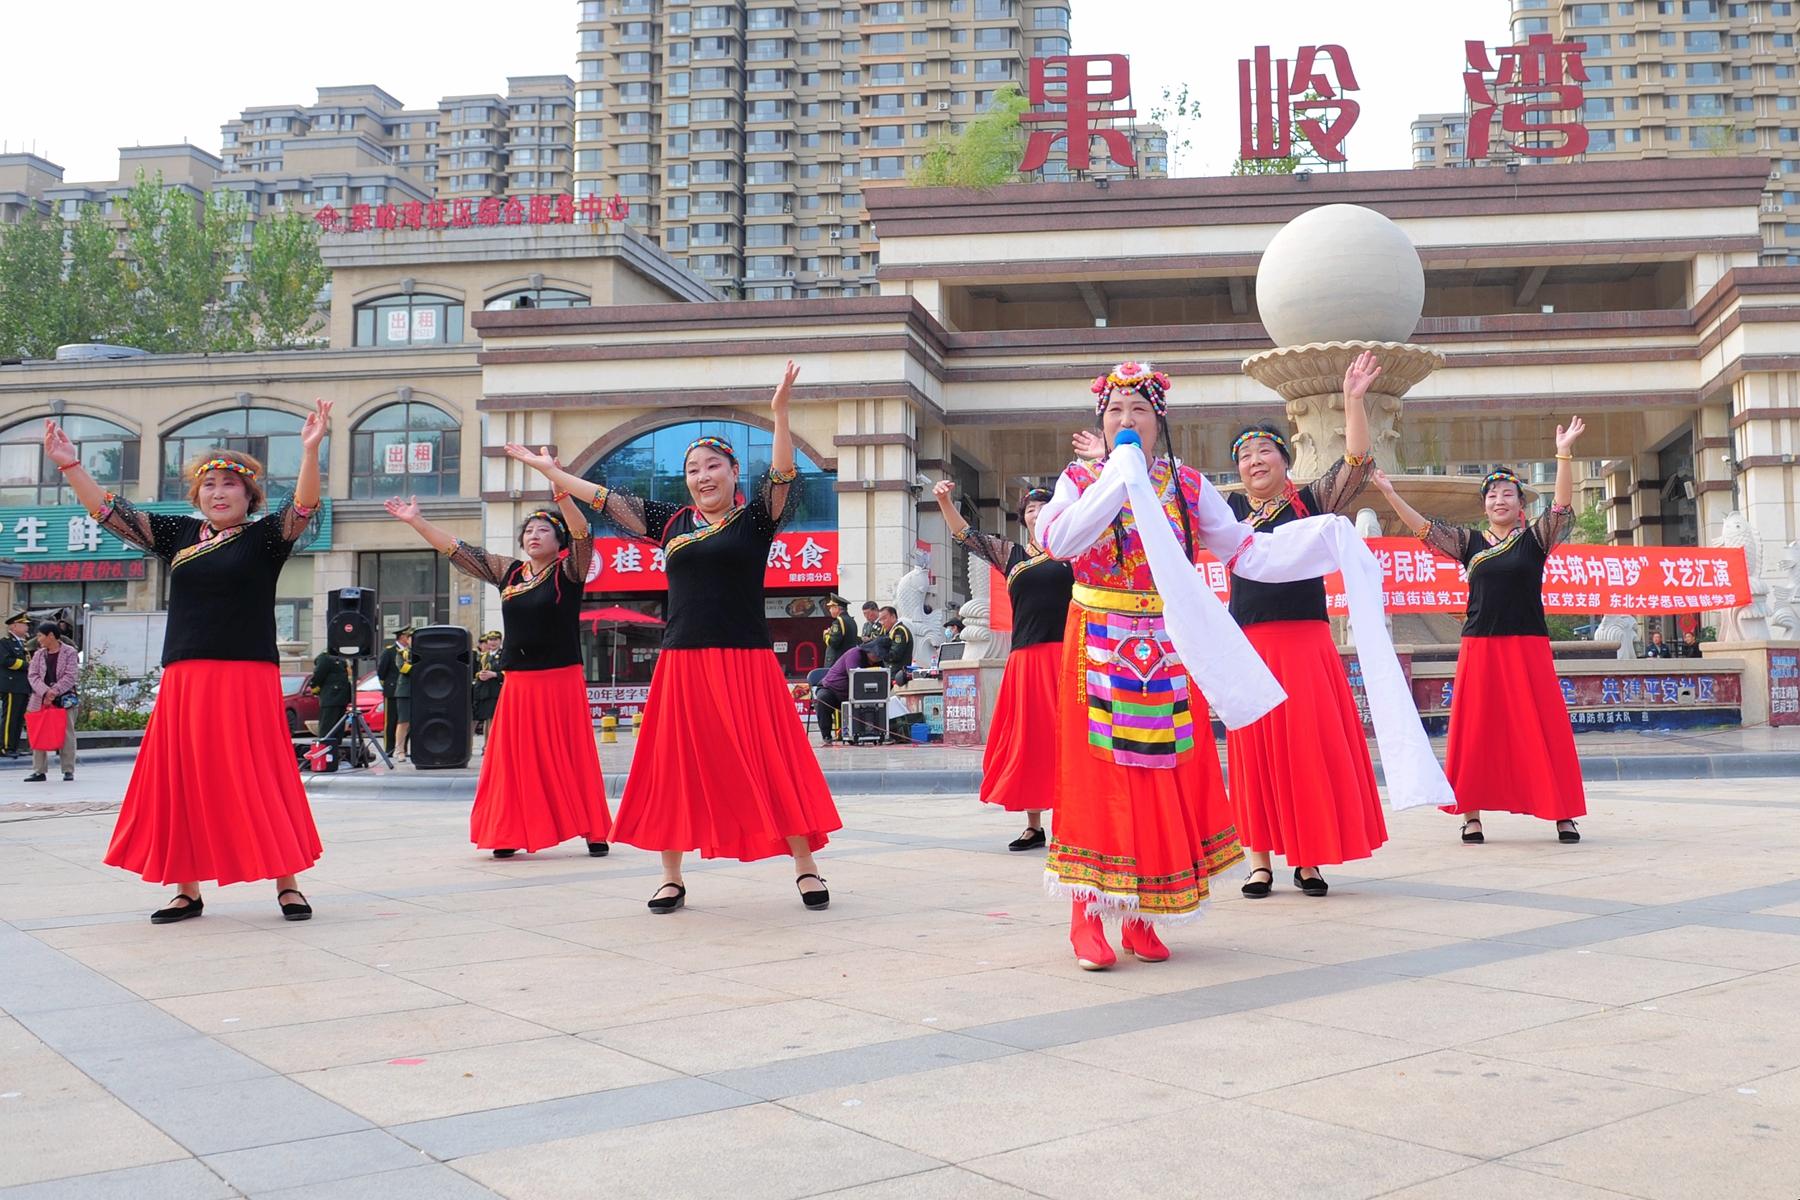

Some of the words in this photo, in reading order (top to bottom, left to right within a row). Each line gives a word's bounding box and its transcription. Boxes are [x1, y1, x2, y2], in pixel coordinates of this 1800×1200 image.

[1018, 33, 1590, 172] 果岭湾
[349, 193, 629, 232] 果岭湾社区综合服务中心
[391, 311, 434, 329] 出租
[388, 444, 431, 462] 出租
[788, 572, 832, 582] 果岭湾分店
[1542, 554, 1649, 587] 共筑中国梦”
[1659, 557, 1732, 588] 文艺汇演
